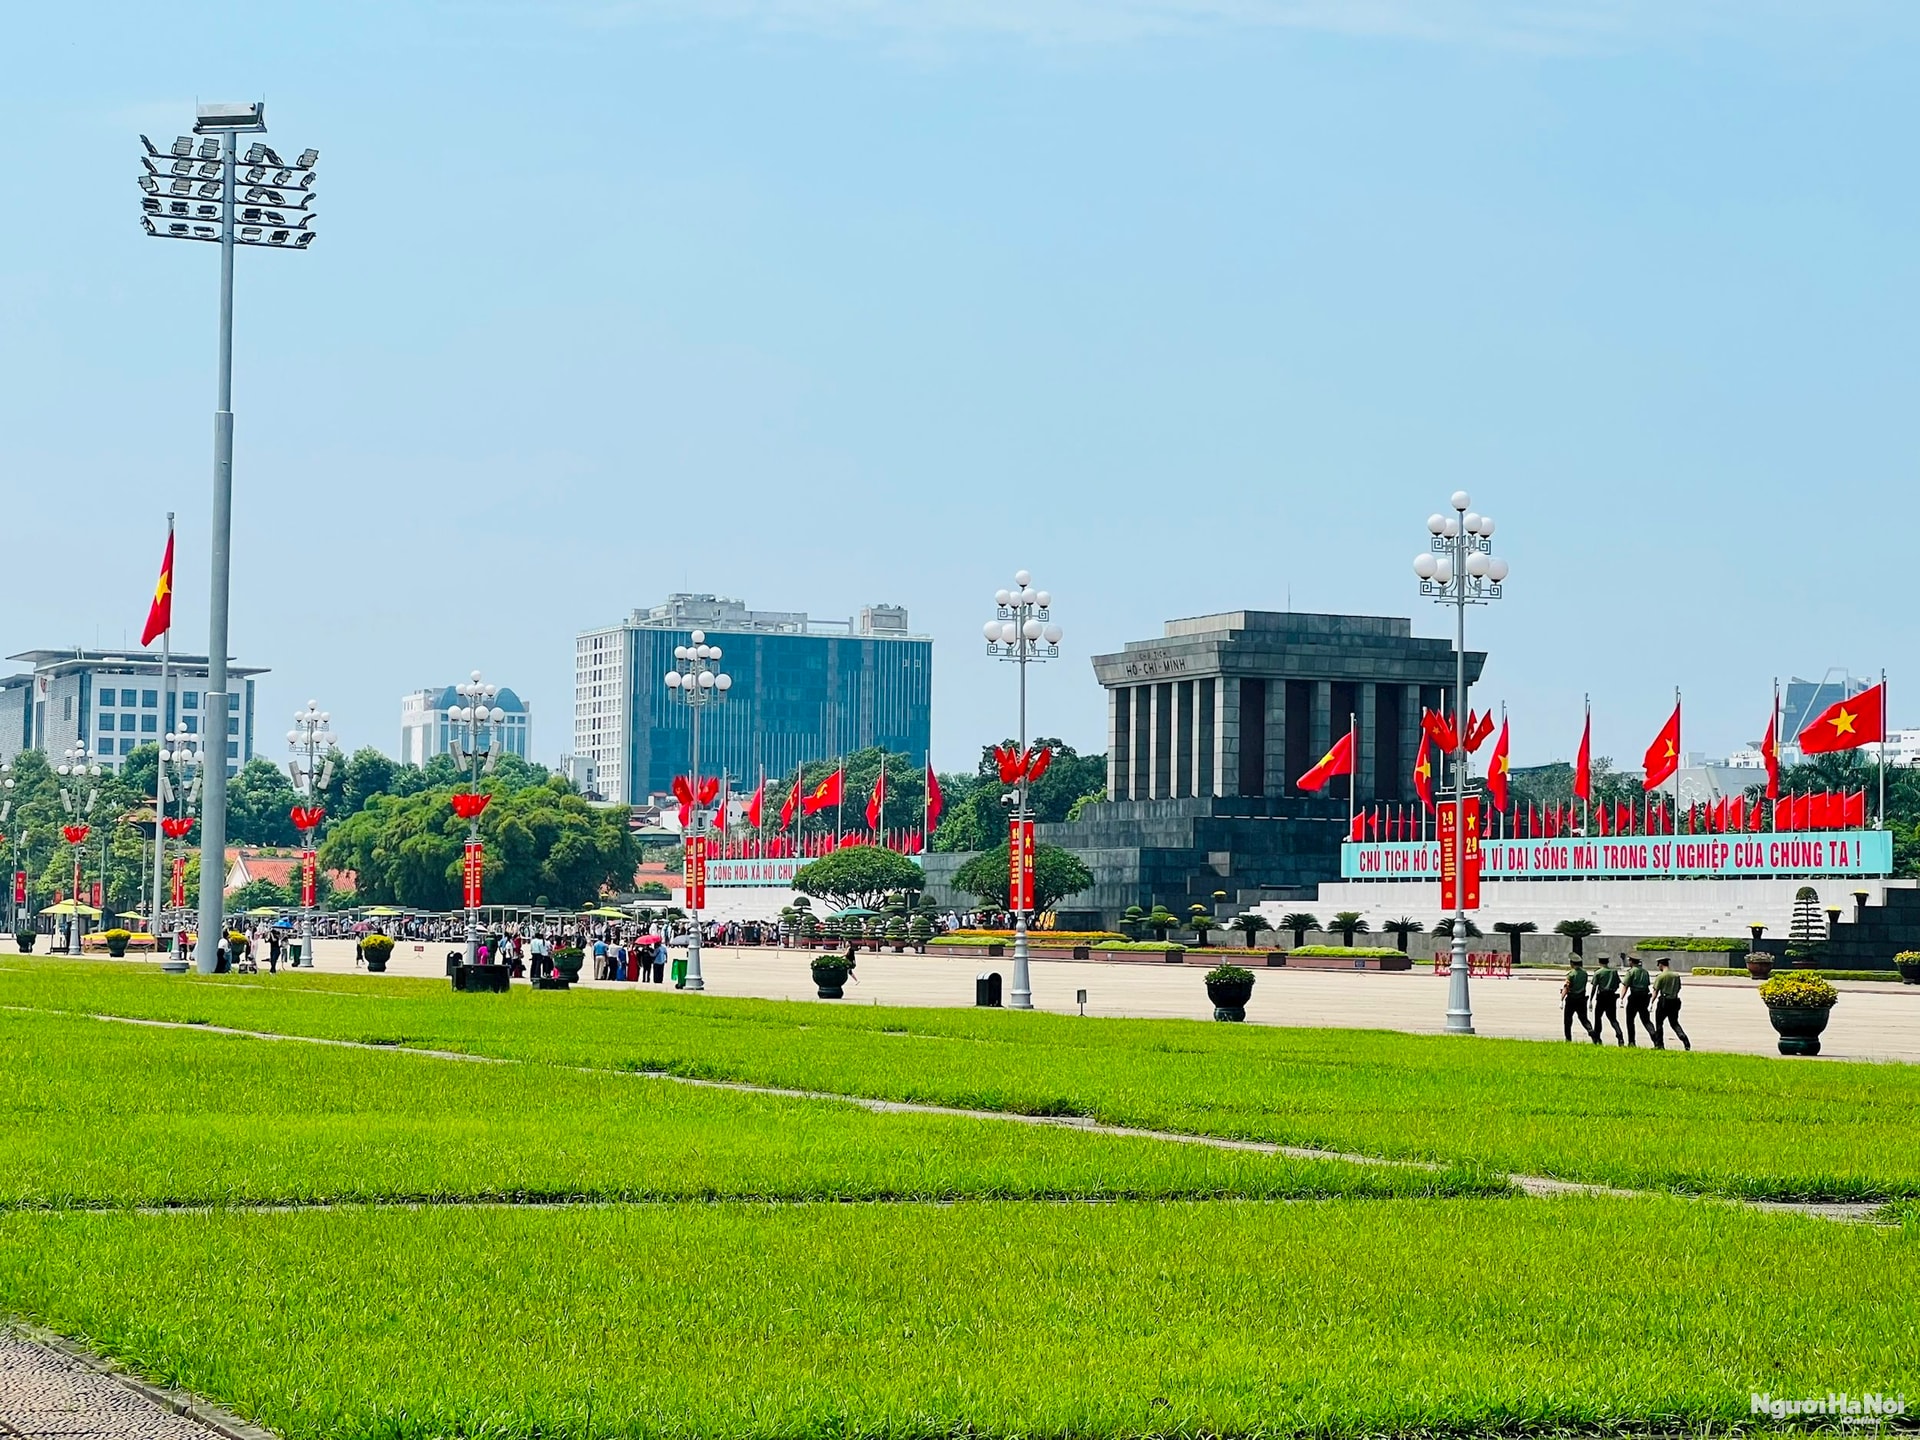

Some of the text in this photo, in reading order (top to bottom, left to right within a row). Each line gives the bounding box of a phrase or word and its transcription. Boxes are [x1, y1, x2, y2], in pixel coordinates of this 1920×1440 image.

[1359, 844, 1381, 872] CHỦ
[1385, 849, 1409, 876] TỊCH
[1492, 843, 1503, 871] VĨ
[1508, 847, 1530, 875] ĐẠI
[1534, 840, 1568, 871] SỐNG
[1573, 843, 1598, 870] MÃI
[1603, 845, 1647, 869] TRONG
[1653, 841, 1672, 873] SỰ
[1676, 838, 1729, 873] NGHIỆP
[1734, 835, 1764, 868] CỦA
[1769, 835, 1823, 868] CHÚNG
[1829, 841, 1849, 867] TA
[713, 862, 732, 884] CỘNG
[763, 862, 775, 884] HỘI
